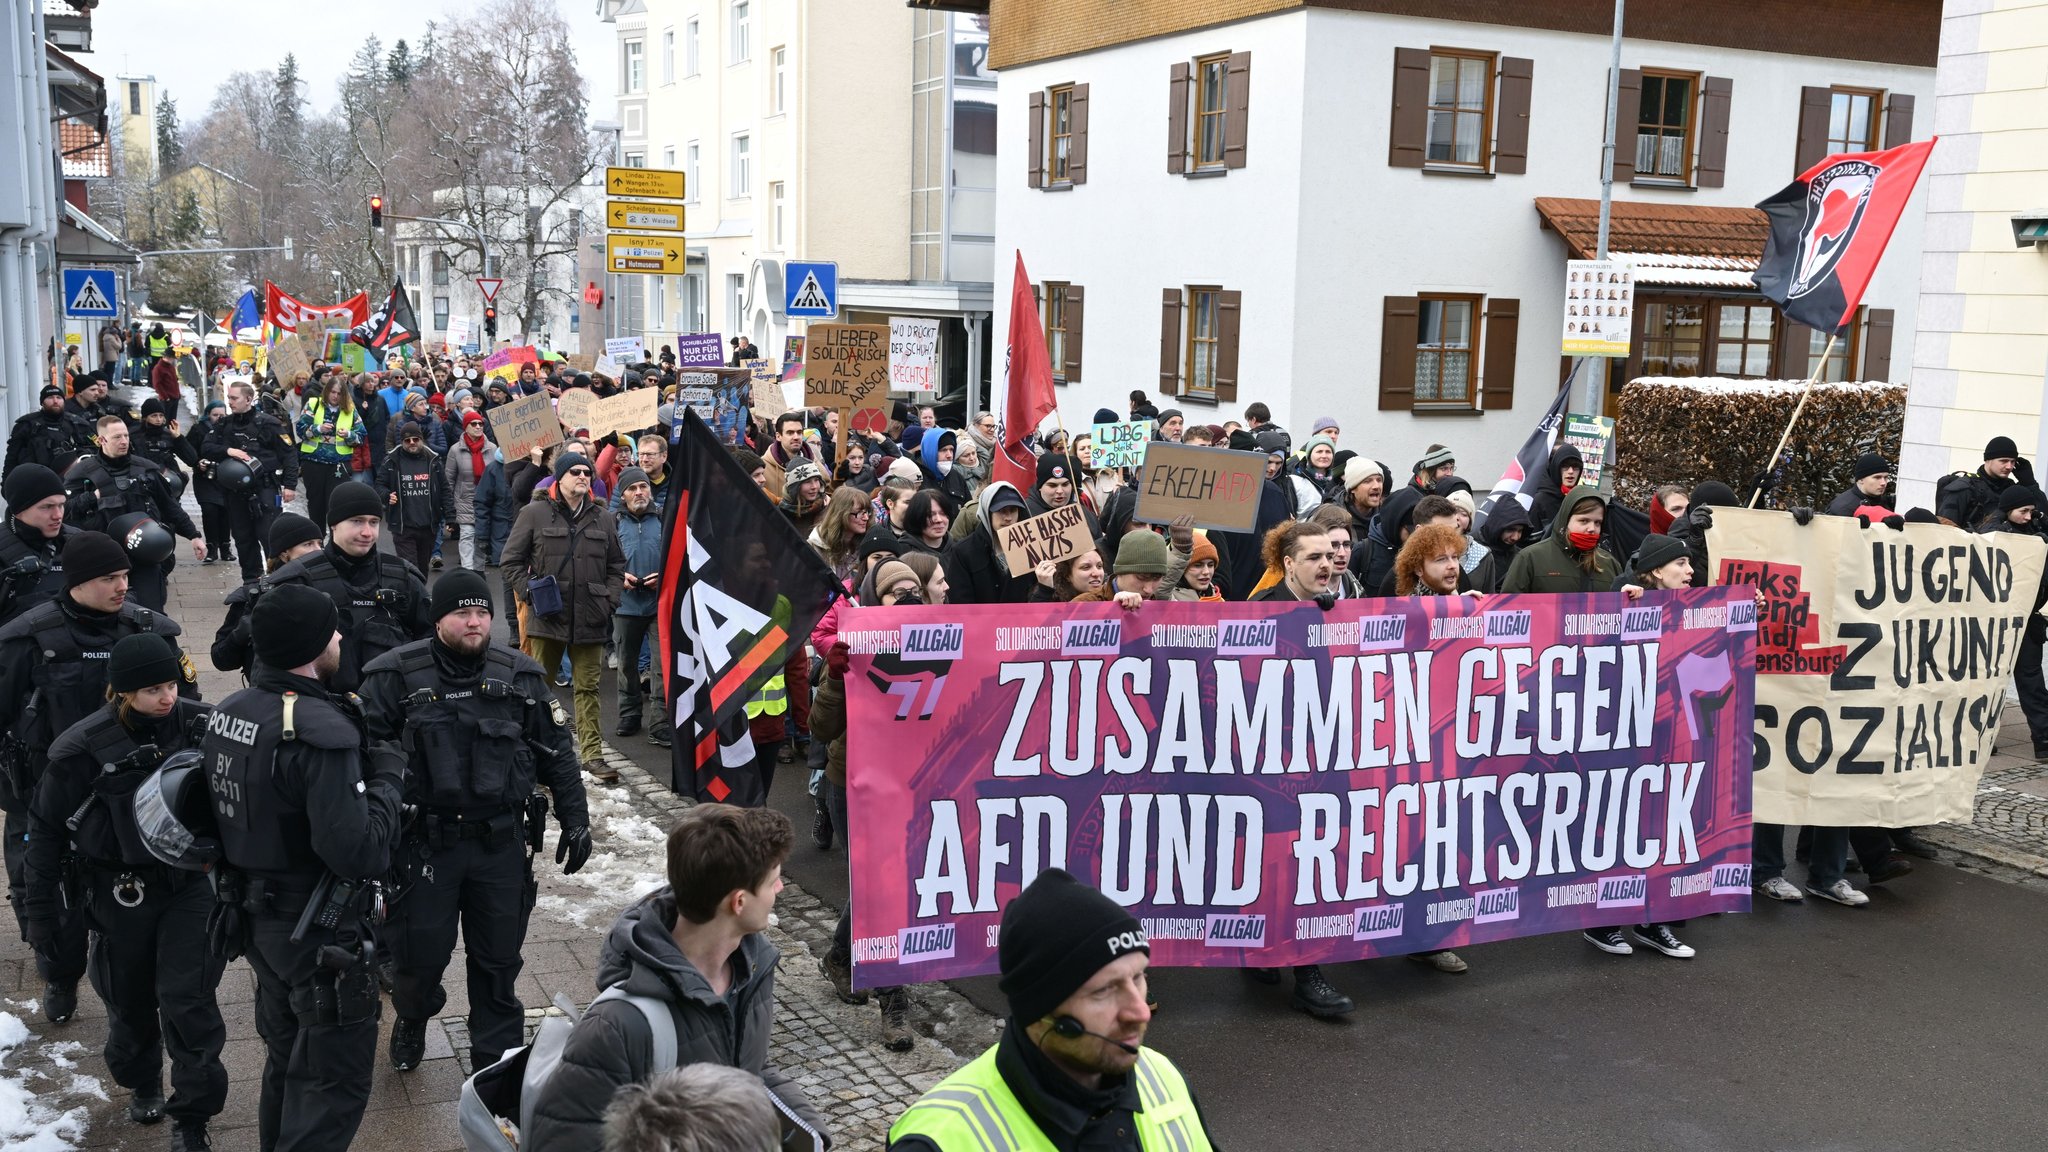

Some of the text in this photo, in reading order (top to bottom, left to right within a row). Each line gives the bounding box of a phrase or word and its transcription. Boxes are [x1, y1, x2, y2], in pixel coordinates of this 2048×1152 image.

[626, 205, 655, 213] Scheidegg
[629, 238, 645, 246] Isny
[682, 338, 718, 346] SCHUBLADEN
[826, 329, 878, 348] LIEBER
[891, 325, 936, 339] WO DRÜCKT
[683, 344, 719, 355] NUR FÜR
[684, 353, 720, 363] SOCKEN
[891, 342, 934, 356] DER SCHUH?
[681, 373, 717, 384] braune Soße
[832, 363, 861, 377] ALS
[893, 364, 929, 390] RECHTS!
[682, 389, 701, 400] gehört
[806, 366, 888, 406] SOLIDE ARISCH
[489, 407, 511, 427] Sollte
[1100, 425, 1143, 445] LDBG
[1113, 442, 1133, 453] bleibt
[1107, 451, 1142, 467] BUNT
[1148, 465, 1256, 504] EKELHAFD
[1008, 505, 1083, 552] ALLE HASSEN
[1025, 531, 1073, 568] NAZIS
[1855, 541, 2013, 610] JUGEND
[459, 598, 489, 608] POLIZEI
[1307, 615, 1406, 648] SOLIDARISCHES ALLGÄU
[1430, 610, 1531, 640] SOLIDARISCHES ALLGÄU
[1565, 606, 1662, 637] SOLIDARISCHES ALLGÄU
[1683, 607, 1726, 630] SOLIDARISCHES
[905, 623, 962, 652] ALLGÄU
[996, 619, 1120, 651] SOLIDARISCHES ALLGÄU
[1152, 620, 1276, 649] SOLIDARISCHES ALLGÄU
[1830, 616, 2024, 691] ZUKUNFT
[445, 690, 473, 700] POLIZEI
[993, 642, 1660, 777] ZUSAMMEN GEGEN
[208, 710, 260, 746] POLIZEI
[216, 753, 232, 777] BY
[212, 773, 240, 802] 6411
[915, 794, 1068, 918] AFD
[1100, 793, 1264, 907] UND
[1293, 761, 1706, 905] RECHTSRUCK
[1547, 876, 1646, 908] SOLIDARISCHES ALLGÄU
[1670, 873, 1712, 897] SOLIDARISCHES
[1426, 889, 1519, 925] SOLIDARISCHES ALLGÄU
[1141, 914, 1265, 941] SOLIDARISCHES ALLGÄU
[1296, 904, 1403, 941] SOLIDARISCHES ALLGÄU
[902, 925, 955, 956] ALLGÄU
